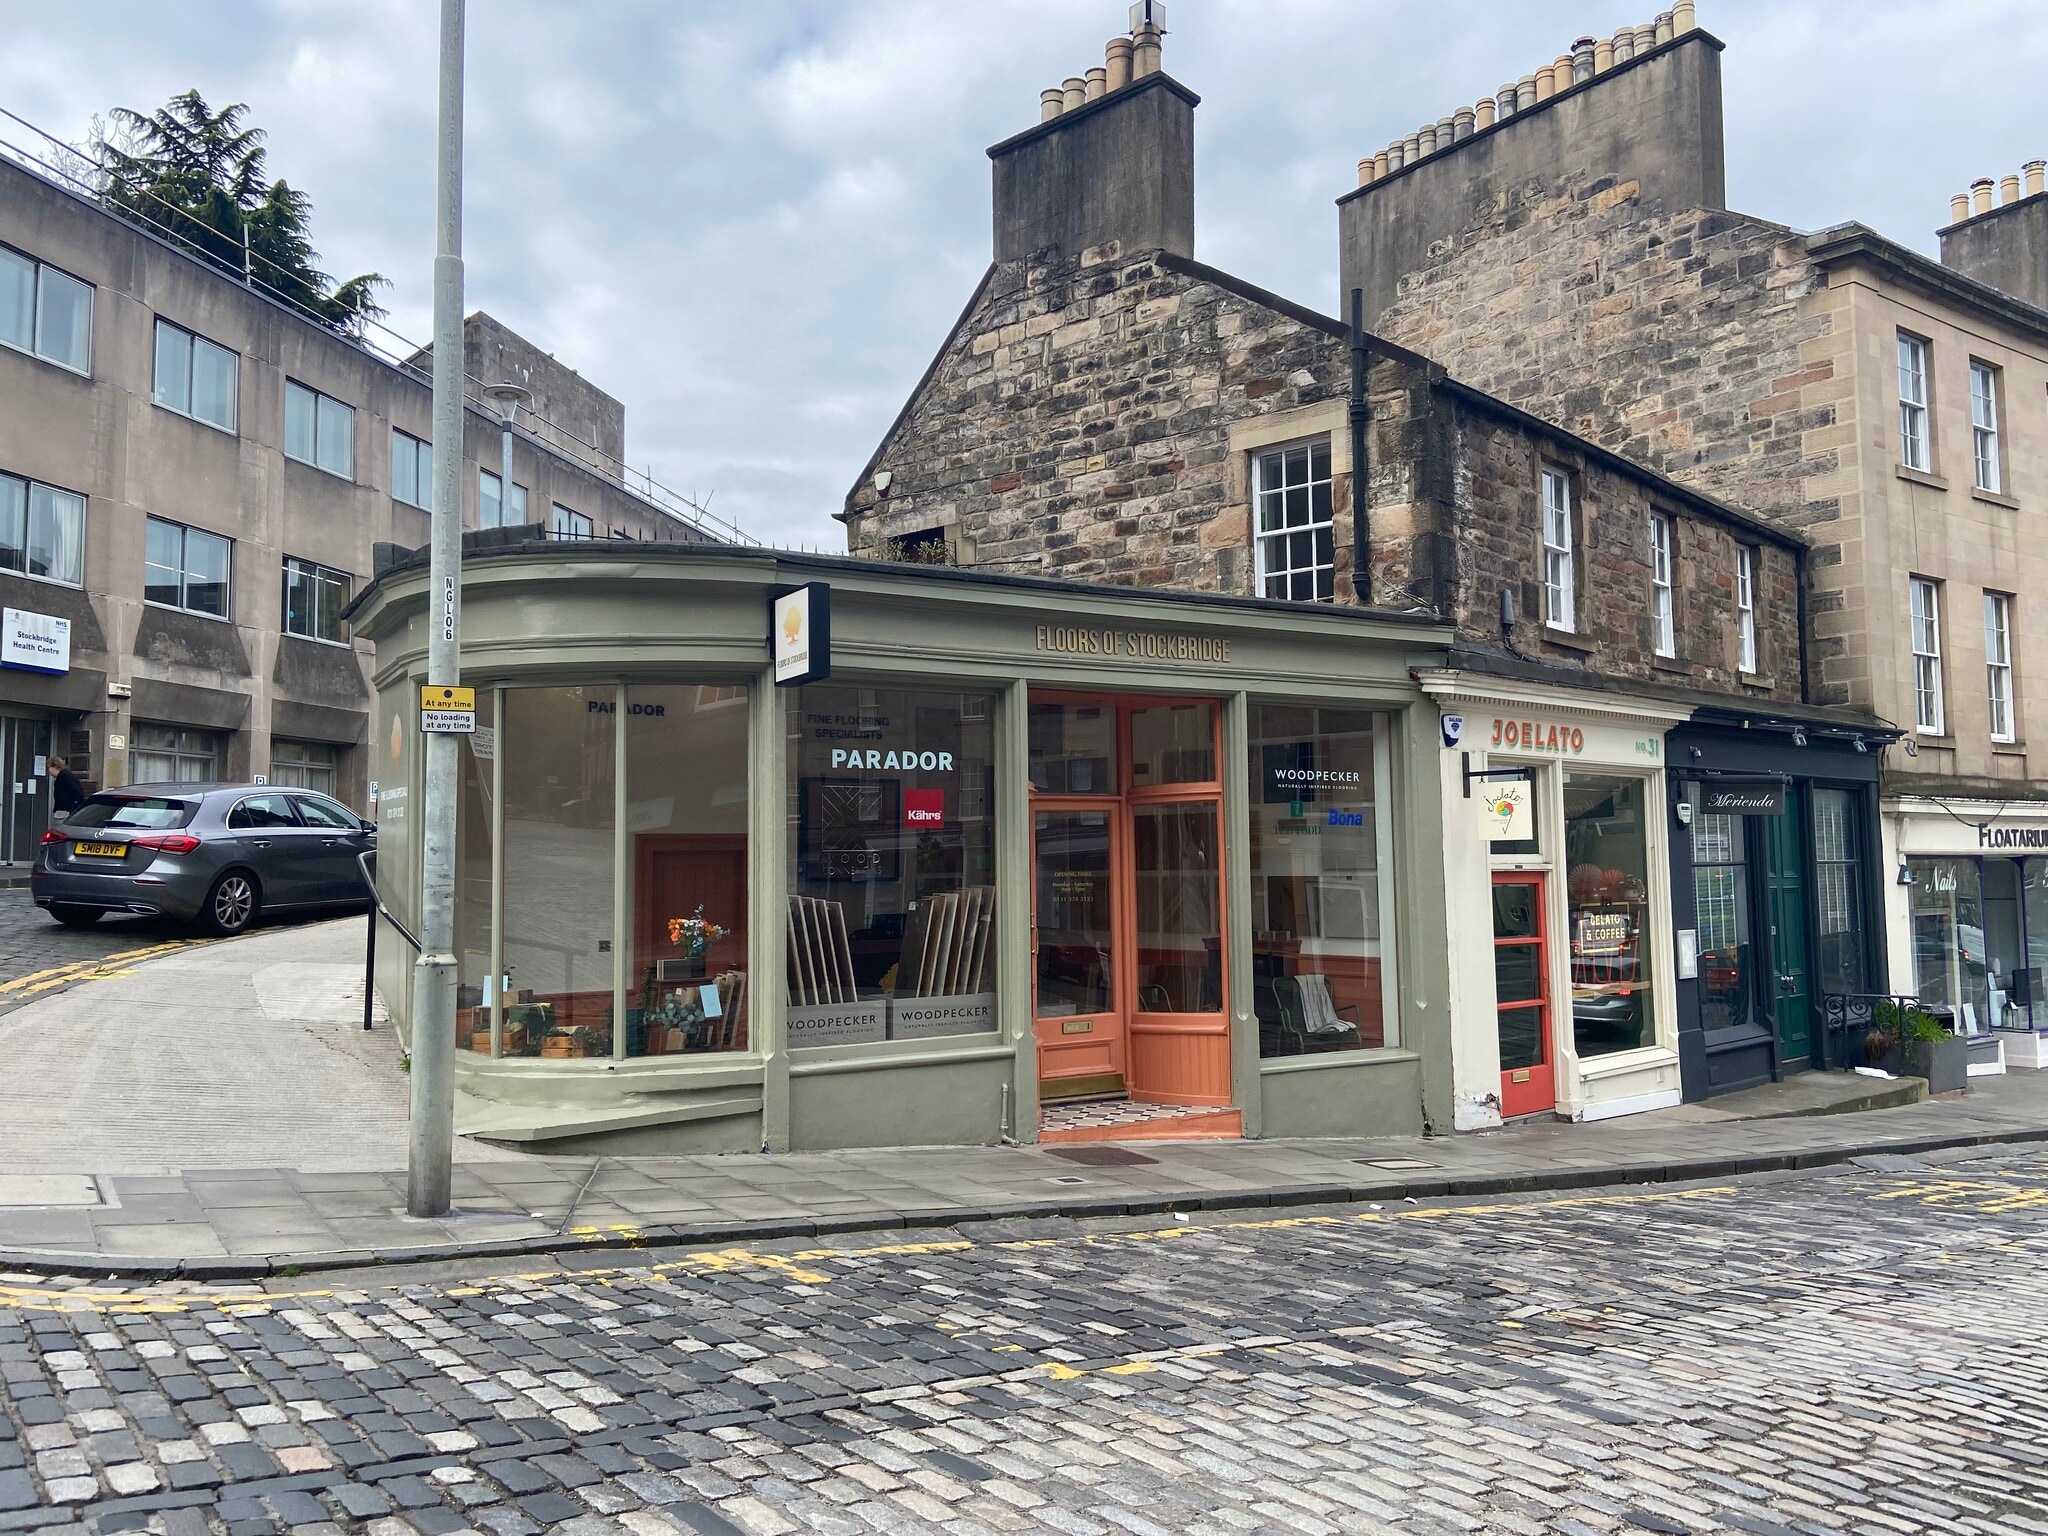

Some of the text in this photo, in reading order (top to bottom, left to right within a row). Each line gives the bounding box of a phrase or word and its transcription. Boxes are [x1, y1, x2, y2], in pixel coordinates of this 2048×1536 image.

[55, 620, 67, 628] NHS
[17, 631, 57, 645] Stockbridge
[1036, 625, 1231, 663] FLOORS OF STOCKBRIDGE
[13, 641, 60, 655] Health Centre
[426, 713, 470, 722] No loading
[808, 714, 889, 727] FINE FLOORING
[815, 728, 882, 740] SPECIALISTS
[1491, 719, 1584, 753] JOELATO
[1648, 738, 1659, 757] 31
[831, 748, 954, 771] PARADOR
[1275, 769, 1360, 782] WOODPECKER
[1708, 793, 1775, 808] Merienda
[908, 809, 942, 821] Kährs
[1328, 808, 1363, 826] Bona
[80, 843, 122, 855] SM18 DVF
[1925, 865, 1957, 893] Nails
[1590, 914, 1621, 926] GELATO
[1586, 928, 1626, 941] & COFFEE
[902, 1006, 989, 1021] WOODPECKER
